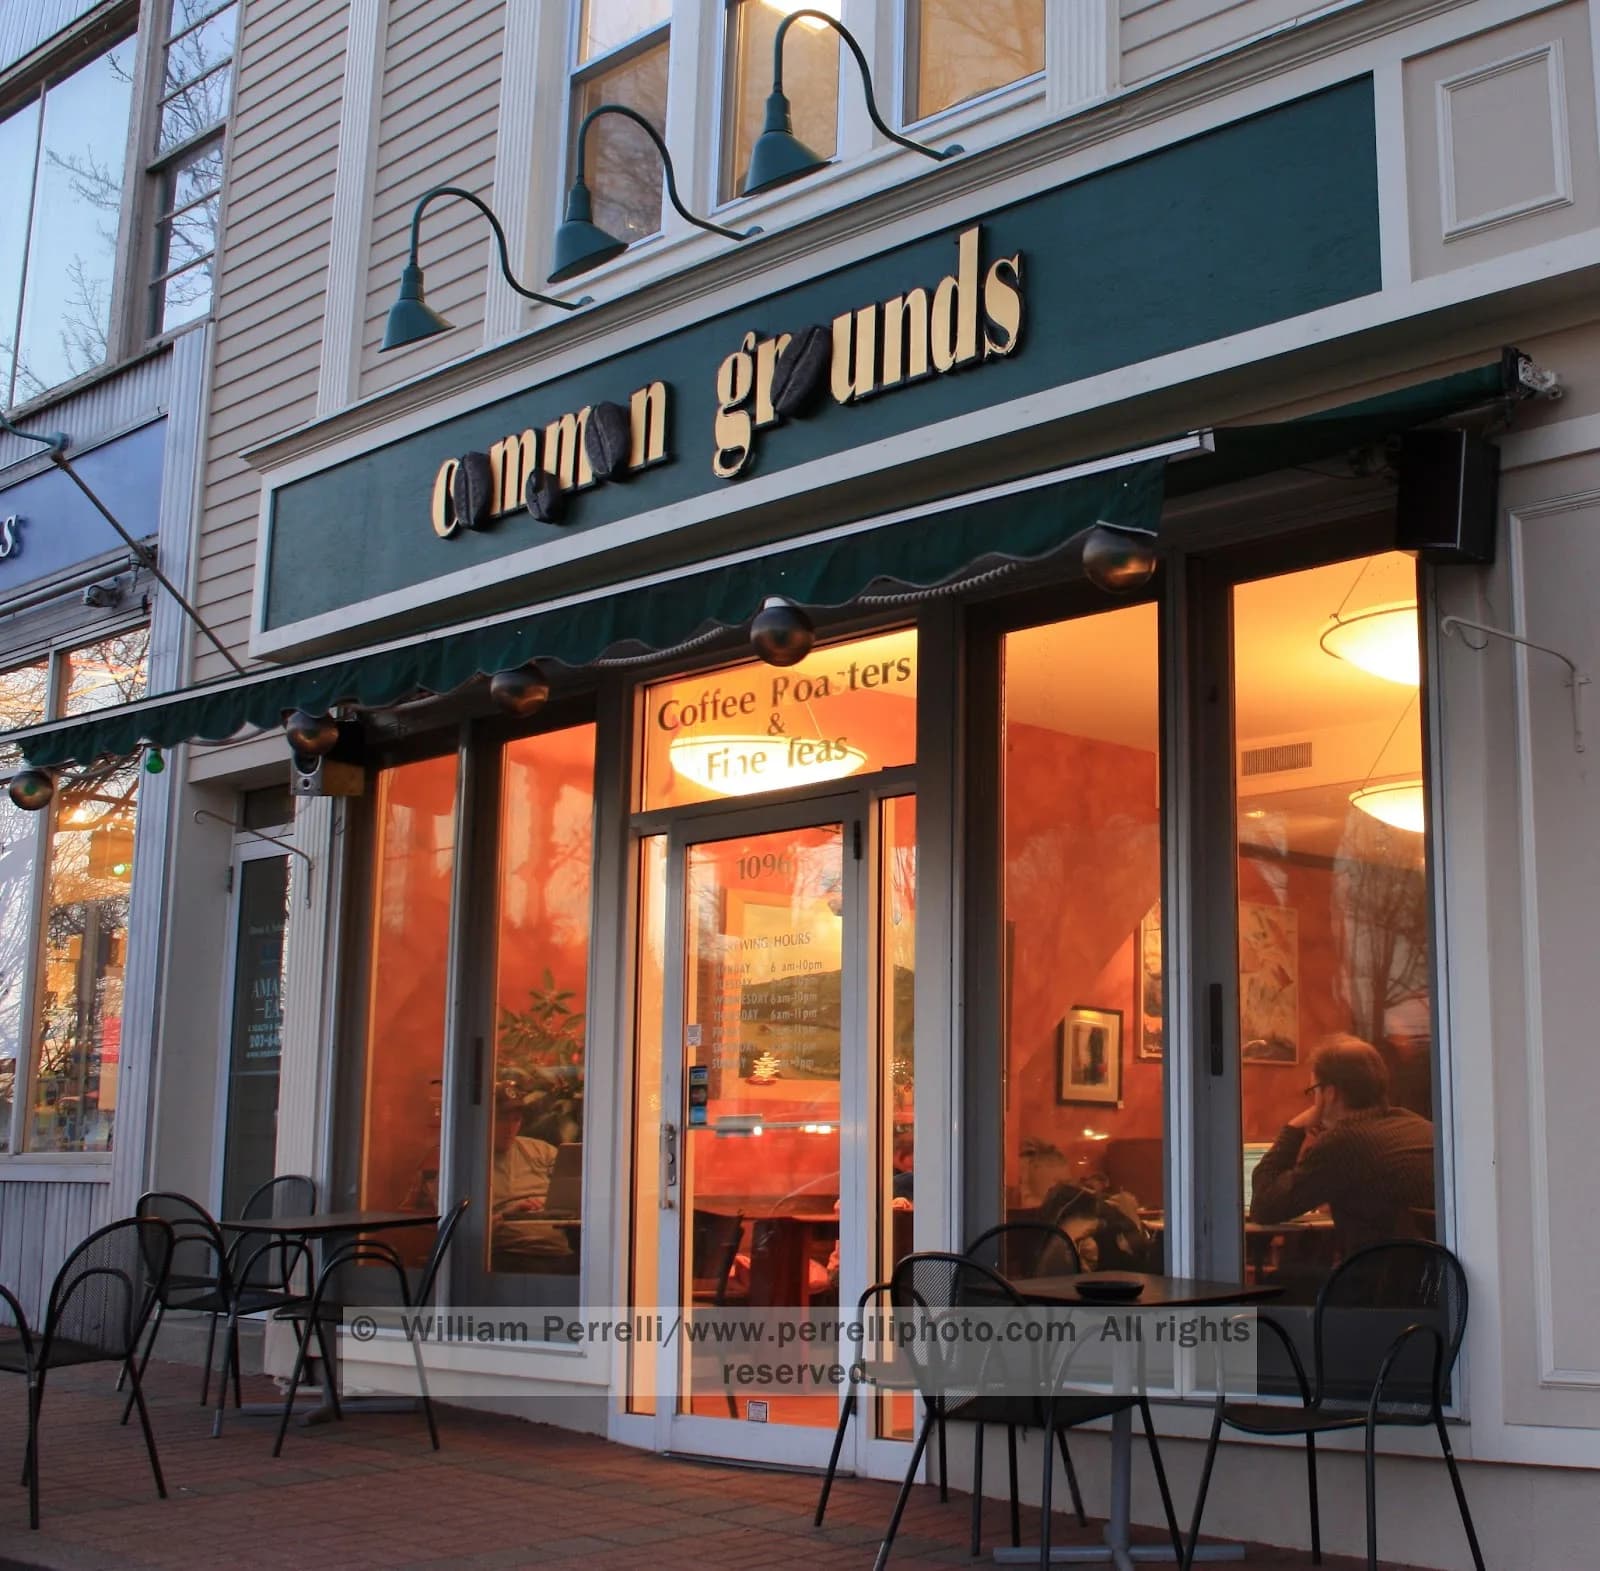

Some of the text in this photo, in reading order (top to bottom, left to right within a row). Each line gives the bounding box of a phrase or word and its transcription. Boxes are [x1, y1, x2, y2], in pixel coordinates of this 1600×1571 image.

[431, 225, 1022, 539] common grounds
[657, 687, 756, 731] Coffee
[767, 712, 785, 736] &
[736, 853, 792, 880] 1096
[717, 932, 811, 953] EWING HOURS
